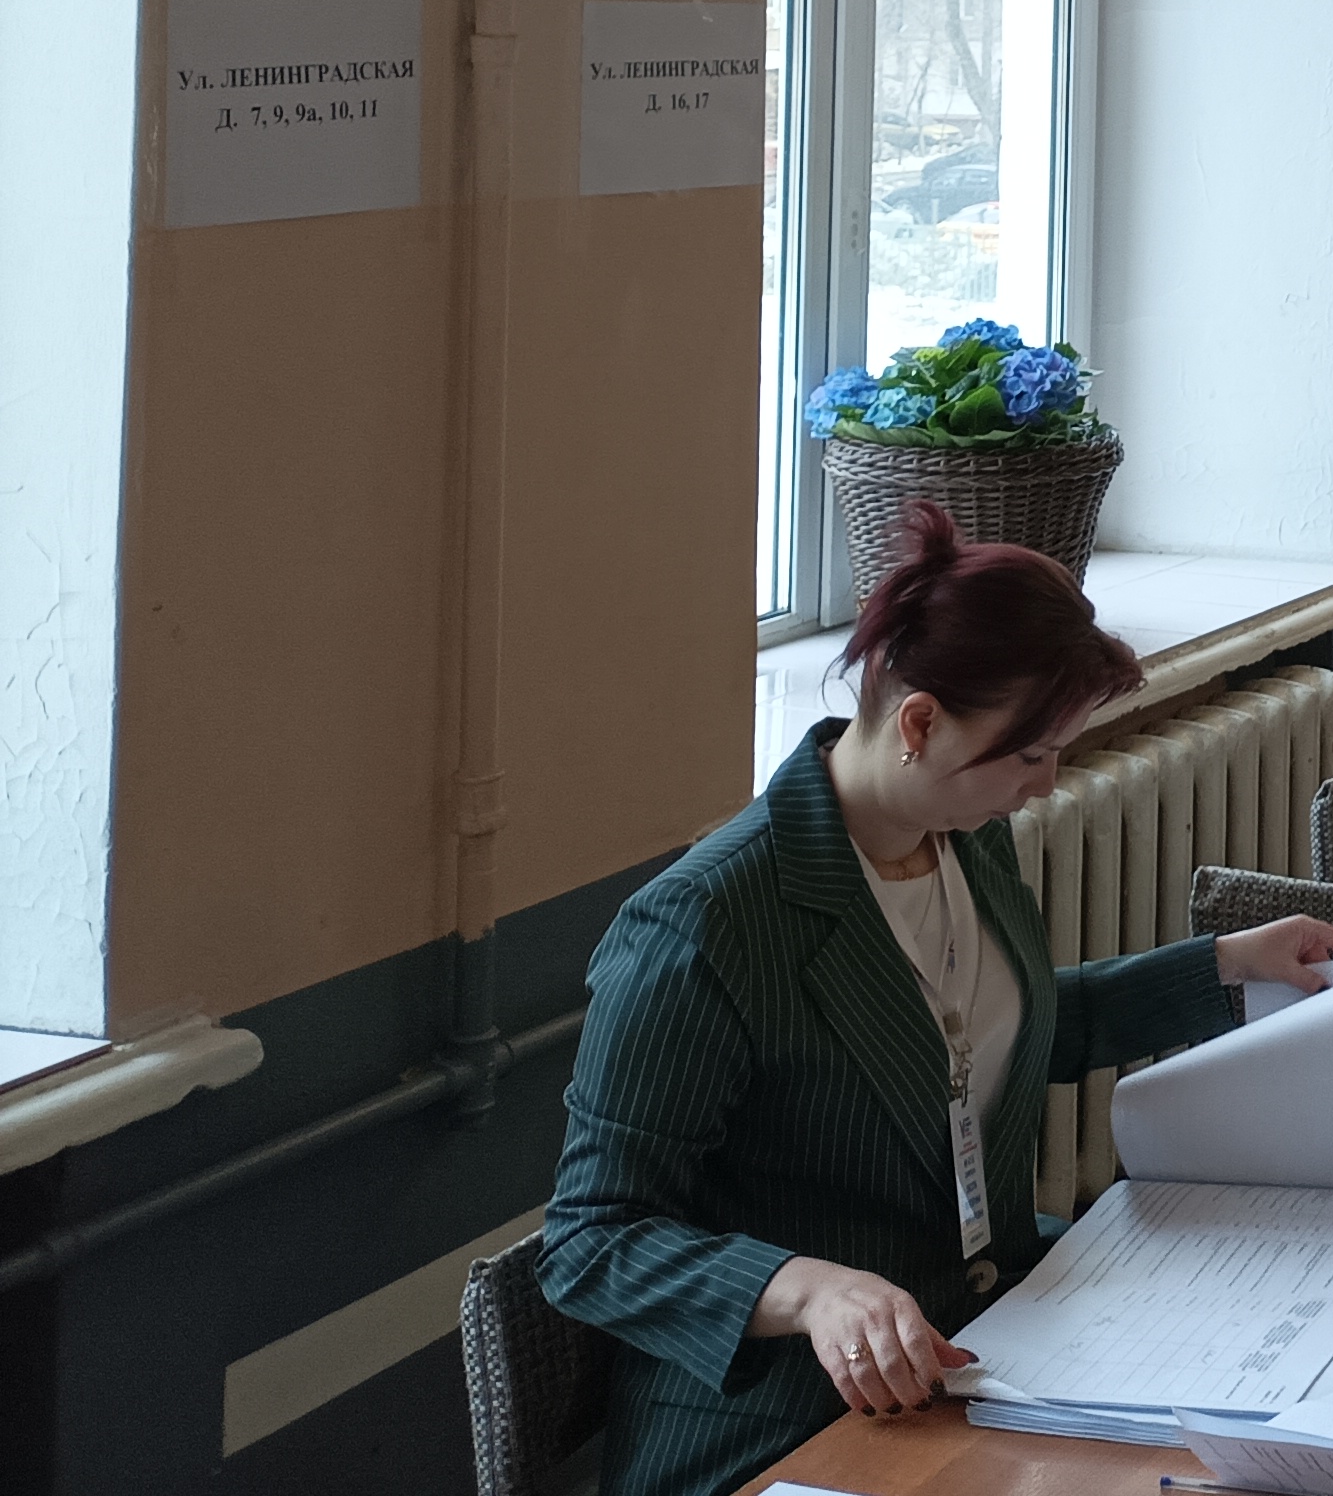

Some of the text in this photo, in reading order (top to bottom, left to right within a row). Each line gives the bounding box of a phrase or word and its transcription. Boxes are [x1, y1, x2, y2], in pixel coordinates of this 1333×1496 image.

[178, 59, 414, 91] Ул. ЛЕНИНГРАДСКАЯ
[590, 58, 759, 80] Ул. ЛЕНИНГРАДСКАЯ
[214, 99, 377, 132] Д. 7, 9, 9а, 10, 11
[644, 91, 710, 114] Д. 16, 17
